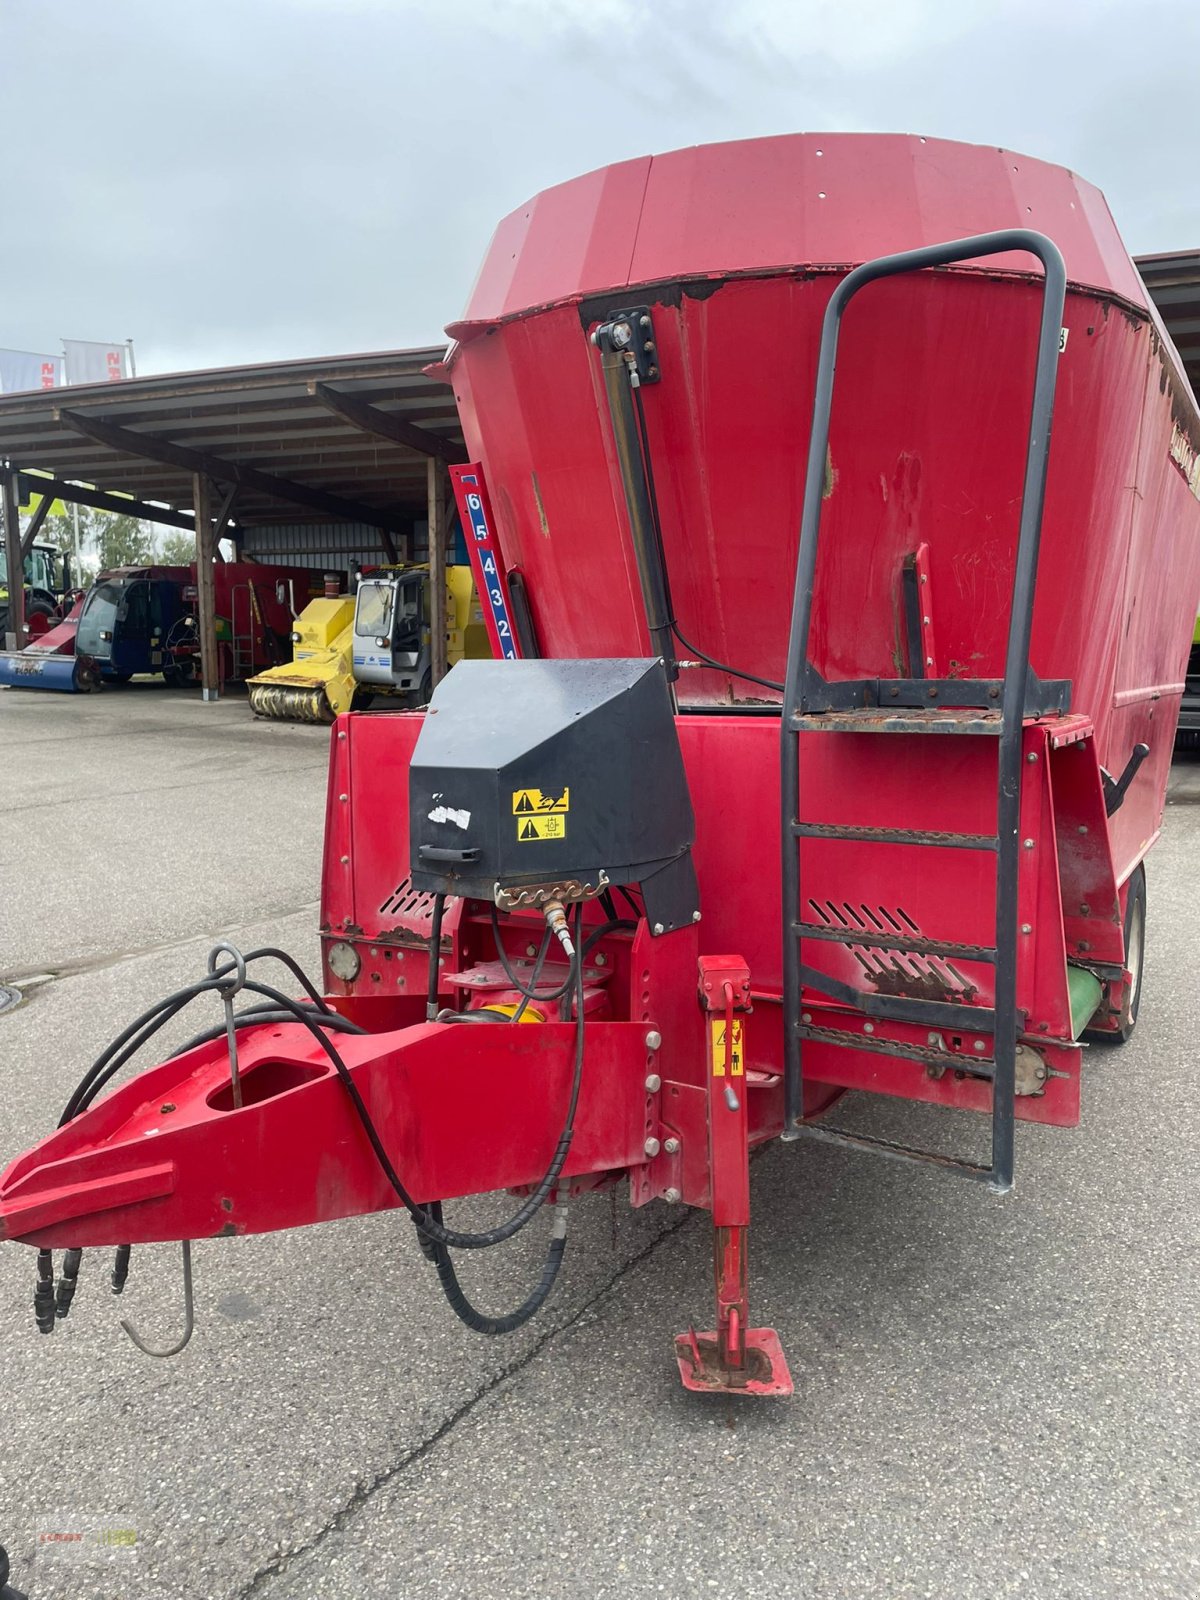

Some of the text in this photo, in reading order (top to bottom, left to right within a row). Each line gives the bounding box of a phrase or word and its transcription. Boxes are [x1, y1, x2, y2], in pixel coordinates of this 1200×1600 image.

[468, 494, 480, 510] 6
[476, 525, 487, 540] 5
[484, 558, 495, 574] 4
[491, 589, 503, 606] 3
[498, 621, 510, 637] 2
